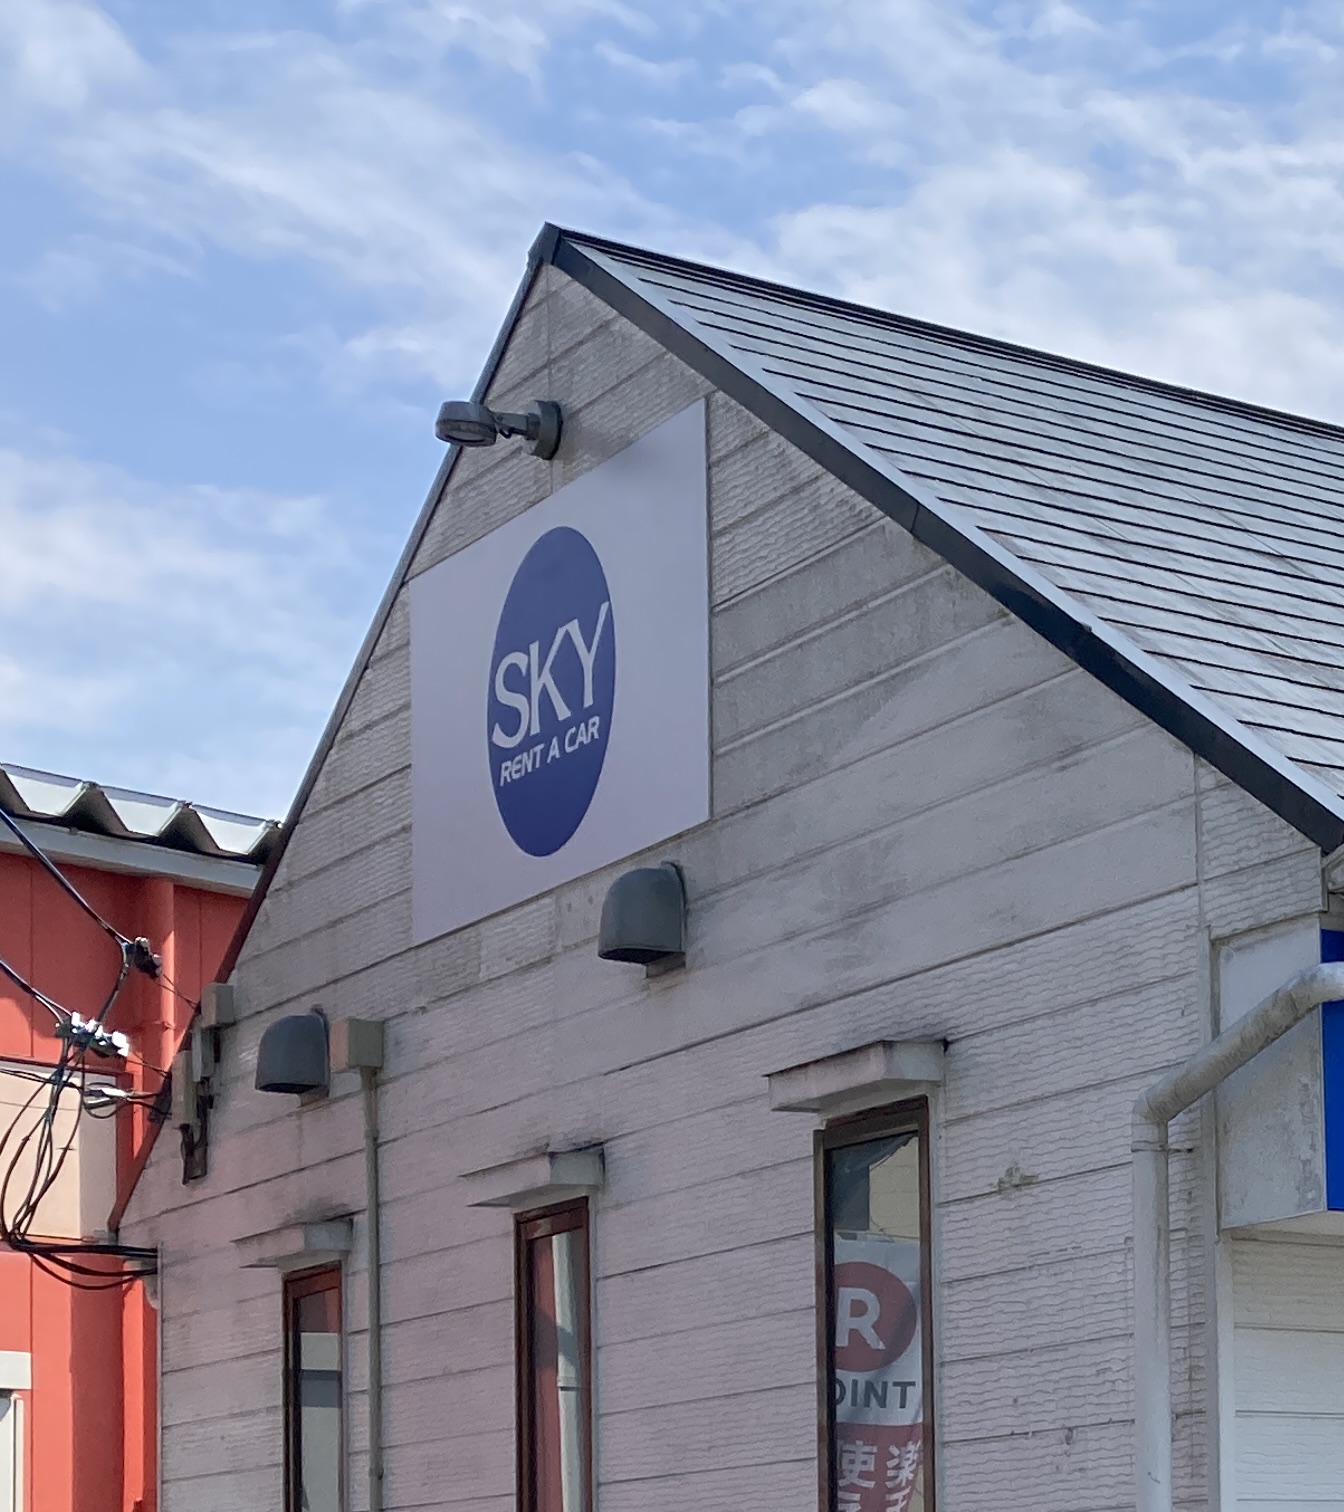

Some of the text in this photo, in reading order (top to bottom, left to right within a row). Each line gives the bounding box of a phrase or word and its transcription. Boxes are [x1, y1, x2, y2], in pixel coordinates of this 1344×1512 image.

[492, 601, 610, 749] SKY
[499, 715, 600, 787] RENT A CAR
[836, 1286, 886, 1350] R
